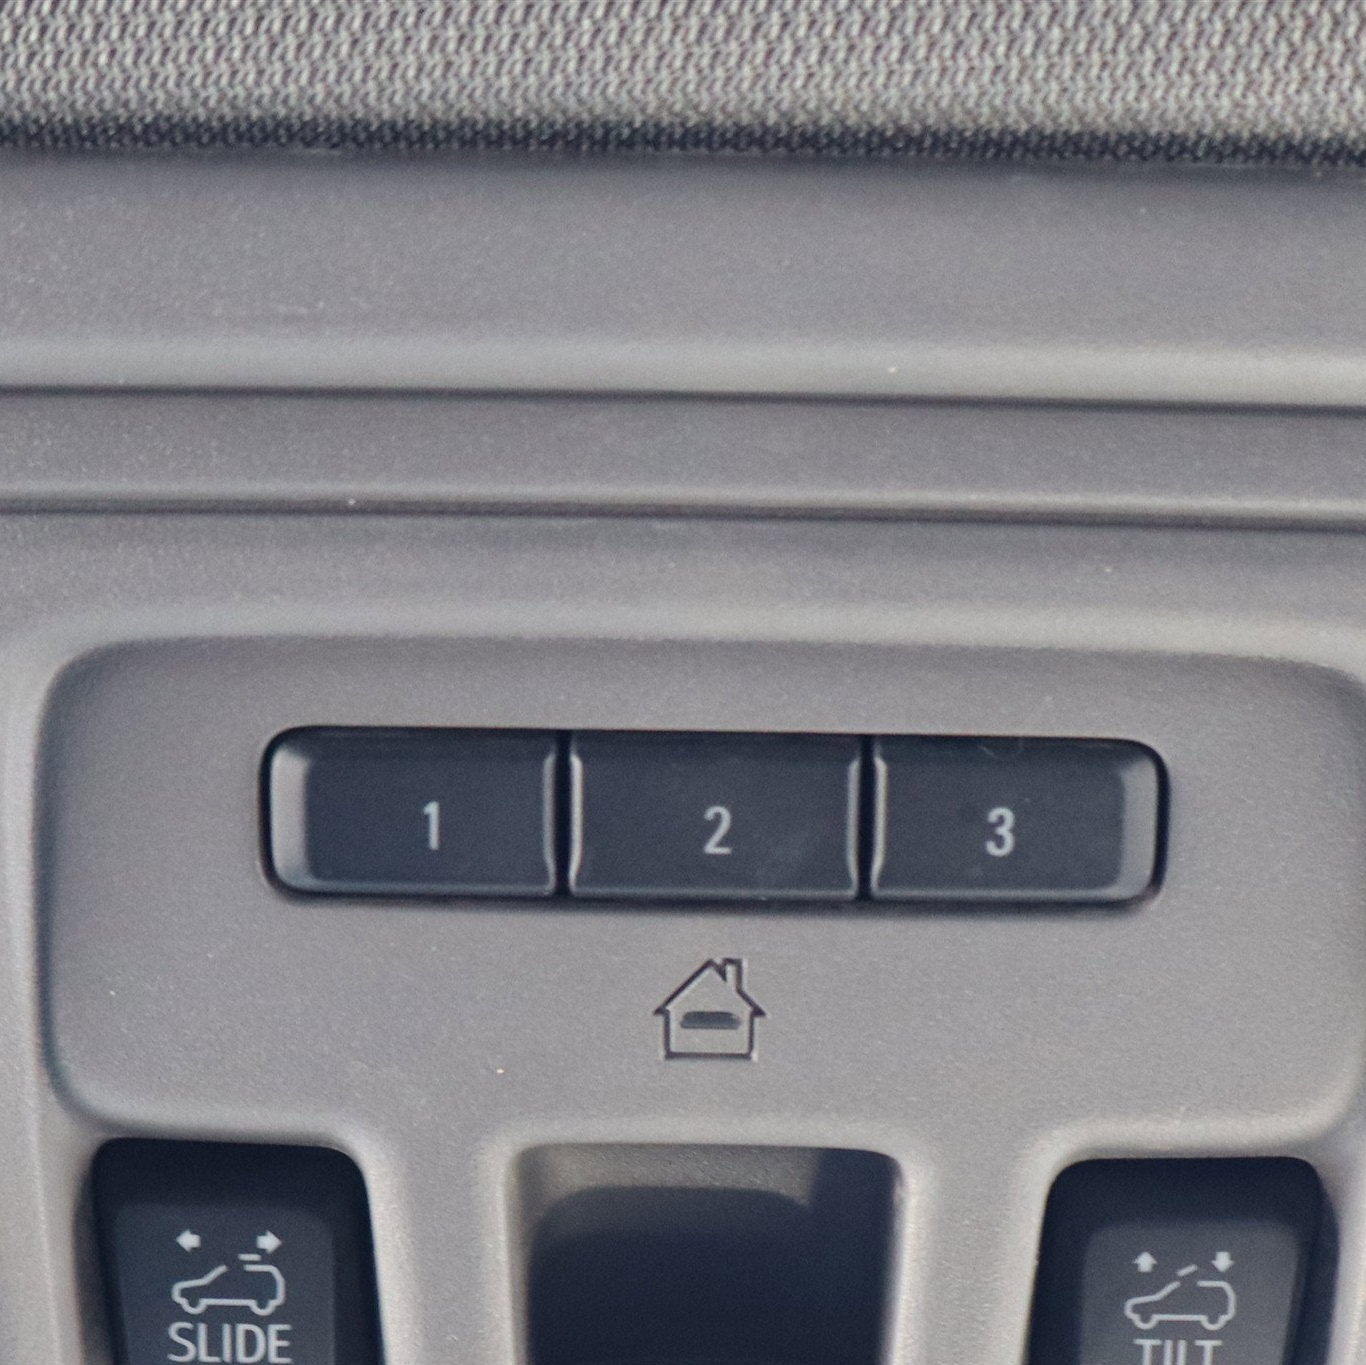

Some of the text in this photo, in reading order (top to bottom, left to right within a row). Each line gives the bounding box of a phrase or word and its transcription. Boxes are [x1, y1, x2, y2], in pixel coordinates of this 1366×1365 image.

[421, 800, 441, 851] 1
[702, 806, 734, 855] 2
[985, 807, 1017, 857] 3
[166, 1321, 294, 1365] SLIDE
